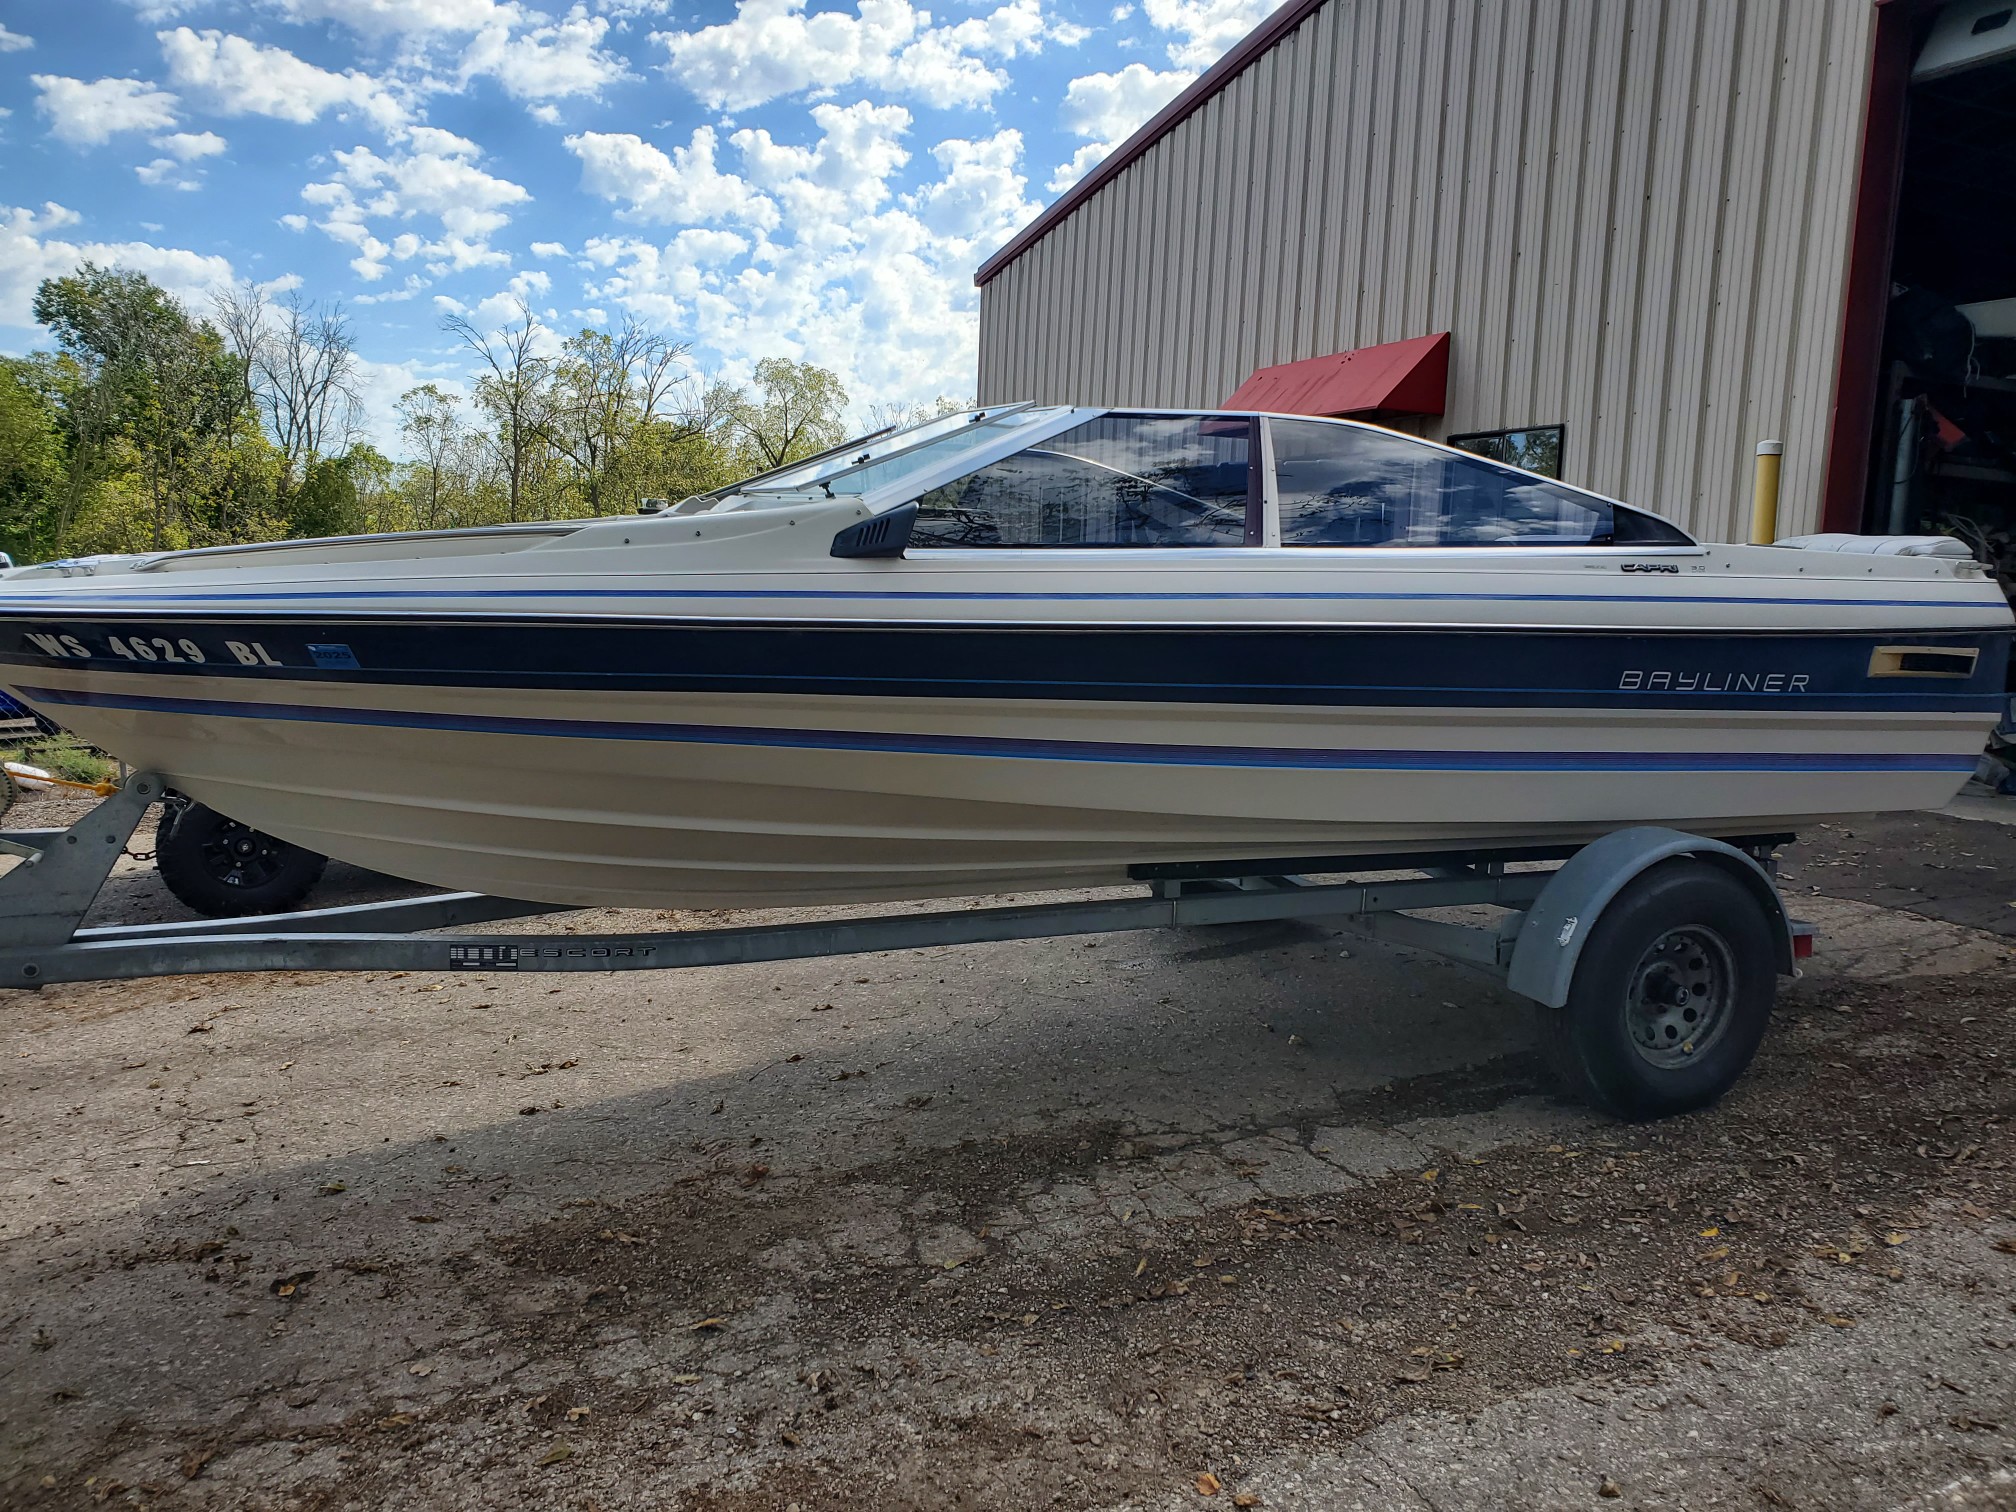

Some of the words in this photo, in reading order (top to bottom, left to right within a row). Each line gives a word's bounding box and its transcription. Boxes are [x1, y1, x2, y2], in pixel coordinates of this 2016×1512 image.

[1621, 563, 1679, 573] CAPRI
[24, 633, 92, 658] WS
[107, 636, 206, 663] 4629
[224, 640, 283, 667] BL
[314, 651, 352, 659] 2025
[1618, 670, 1810, 692] BAYLINER
[518, 946, 657, 958] ESCORT
